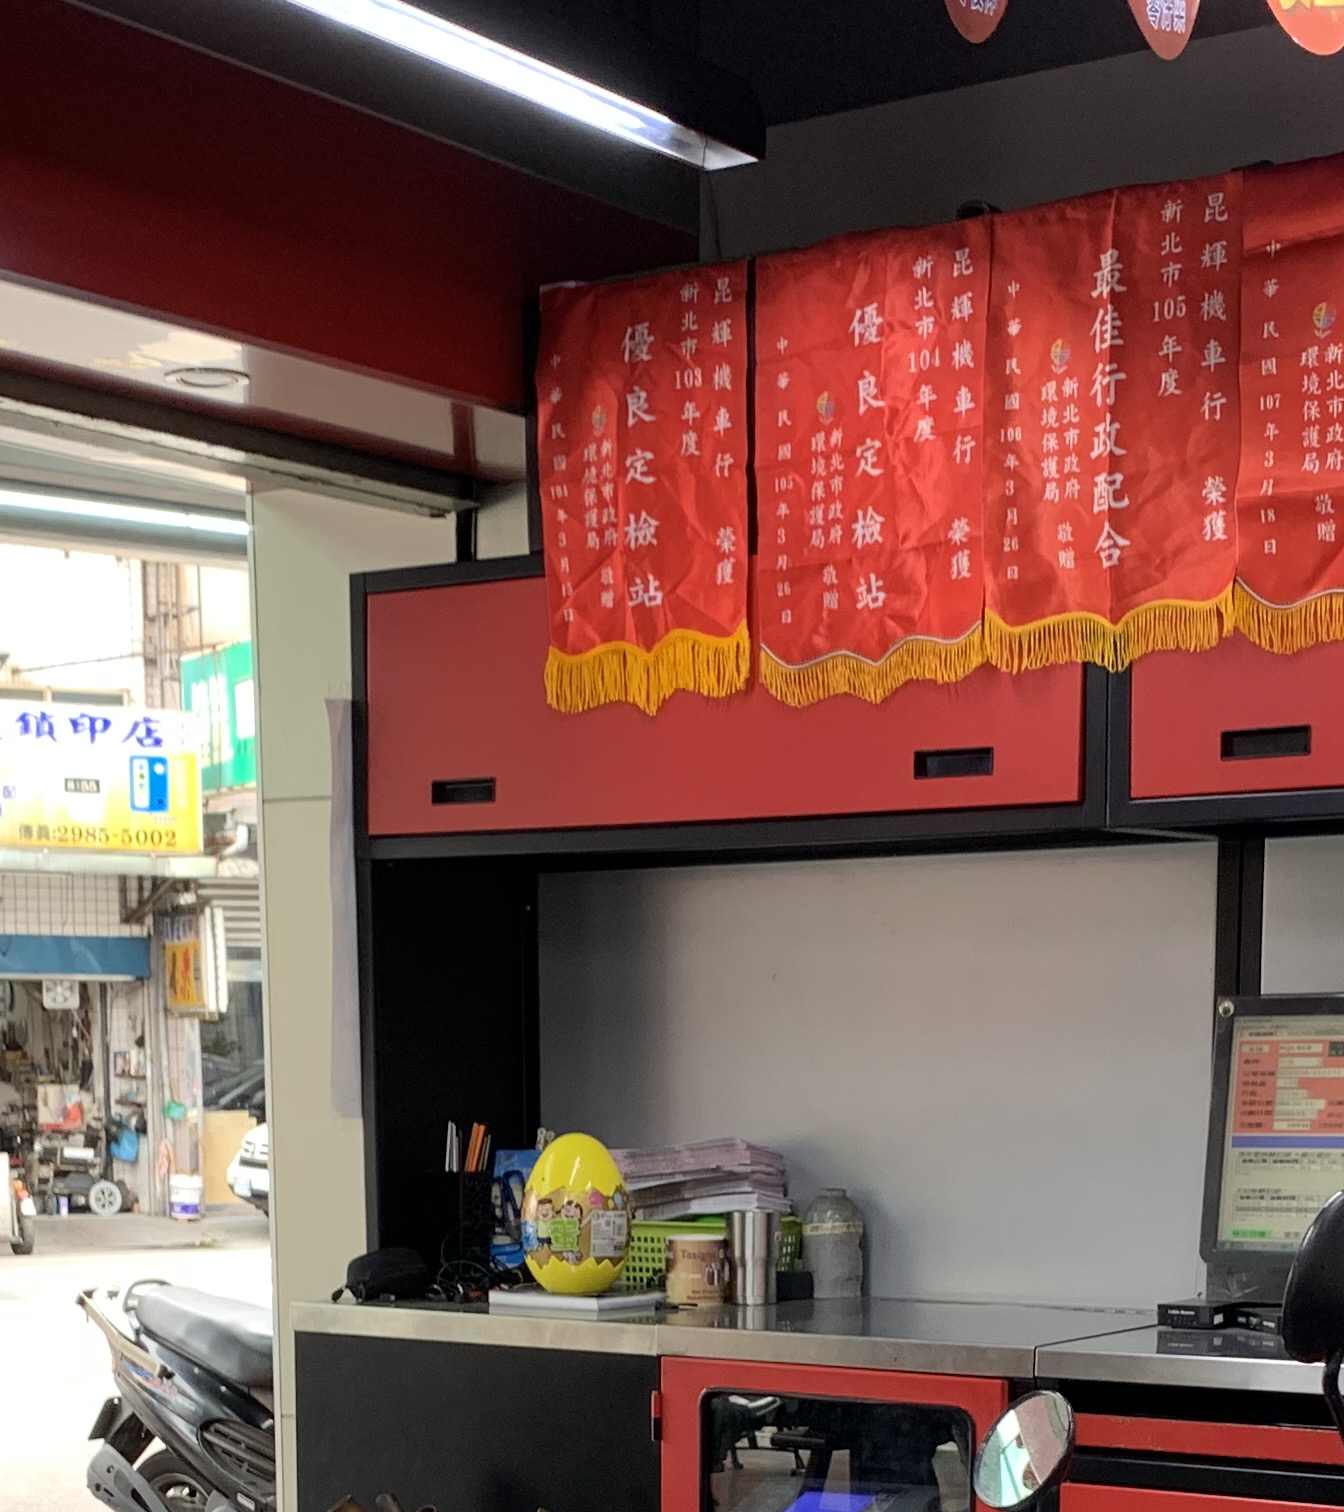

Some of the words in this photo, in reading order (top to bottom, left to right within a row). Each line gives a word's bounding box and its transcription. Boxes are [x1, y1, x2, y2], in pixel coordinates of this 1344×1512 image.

[951, 248, 975, 464] 昆輝機車行
[1152, 200, 1187, 397] 新北市105年度
[1201, 192, 1228, 422] 昆輝機車行
[713, 277, 736, 478] 昆輝機車行
[1062, 377, 1081, 500] 新北市政府
[1090, 250, 1131, 568] 最佳行政配合
[1300, 346, 1321, 474] 環境保護局
[1324, 343, 1344, 472] 新北市政府
[584, 443, 600, 550] 環境保護局
[601, 440, 618, 546] 新北市政府
[622, 322, 663, 607] 優良定檢站
[810, 431, 827, 549] 環境保護局
[828, 427, 844, 545] 新北市政府
[850, 302, 886, 609] 優良定檢站
[1041, 381, 1060, 503] 環境保護局
[715, 528, 736, 584] 榮獲
[947, 517, 971, 579] 榮獲
[1201, 476, 1228, 542] 榮獲
